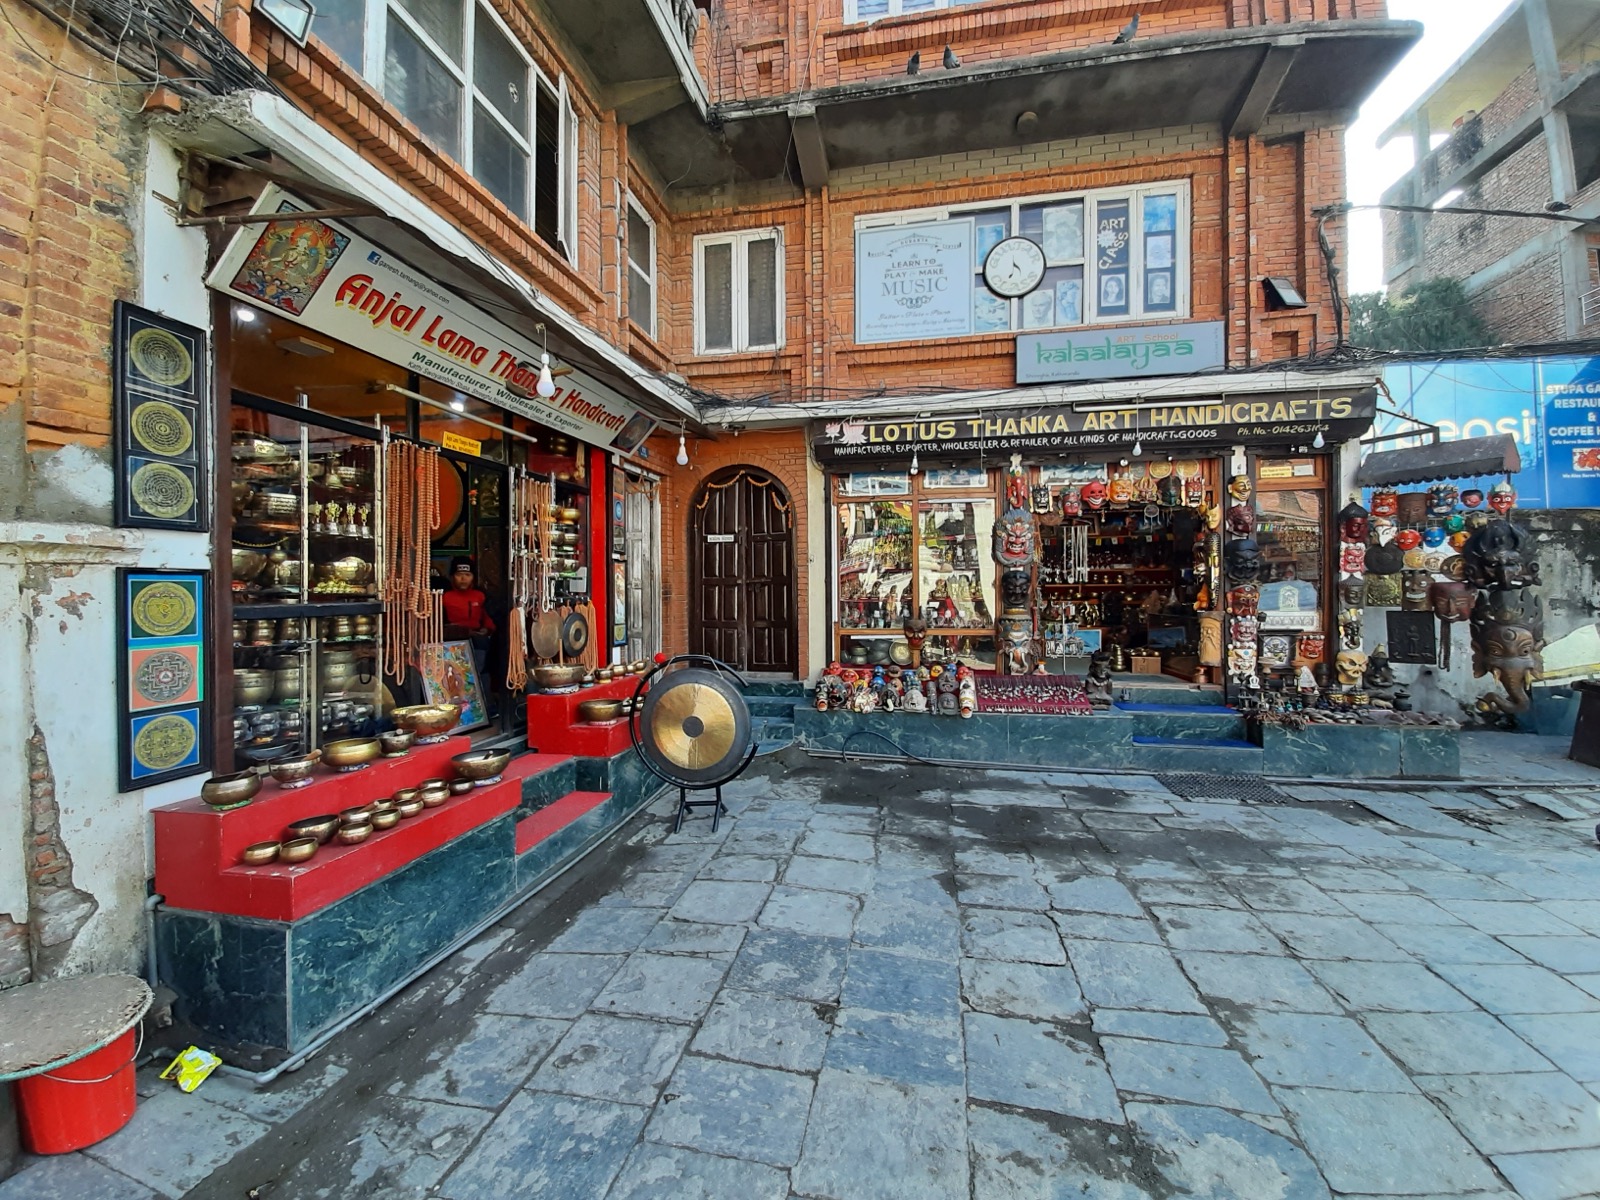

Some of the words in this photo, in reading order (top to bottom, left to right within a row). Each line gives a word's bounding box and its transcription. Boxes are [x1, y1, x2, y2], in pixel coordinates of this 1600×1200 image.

[1099, 217, 1126, 230] ART
[989, 241, 1041, 269] GUITAR
[891, 259, 921, 269] LEARN
[884, 271, 907, 279] PLAY
[919, 268, 944, 276] MAKE
[881, 276, 948, 297] MUSIC
[990, 271, 1038, 293] CLASS
[1116, 335, 1136, 343] ART
[1144, 333, 1179, 342] School
[335, 273, 426, 329] Anjal
[420, 315, 489, 368] Lama
[488, 349, 564, 404] Thanga
[559, 388, 627, 433] Handicraft
[1036, 336, 1195, 370] kalaalayaa
[412, 351, 492, 394] Manufacturer,
[496, 388, 545, 415] Wholesaler
[553, 415, 583, 432] Exporter
[1546, 384, 1584, 394] STUPA
[1554, 398, 1600, 409] RESTAU
[869, 421, 956, 443] LOTUS
[966, 414, 1070, 438] THANKA
[1082, 409, 1138, 431] ART
[1150, 397, 1353, 427] HANDICRAFTS
[1587, 411, 1597, 422] &
[1237, 427, 1250, 436] Ph.
[1549, 425, 1594, 437] COFFEE
[834, 444, 894, 456] MANUFACTURER,
[1000, 439, 1010, 448] &
[1010, 438, 1049, 448] RETAILER
[1051, 437, 1062, 445] OF
[1063, 435, 1078, 445] ALL
[1080, 433, 1105, 444] KINDS
[1107, 433, 1119, 442] OF
[1178, 429, 1218, 440] GOODS
